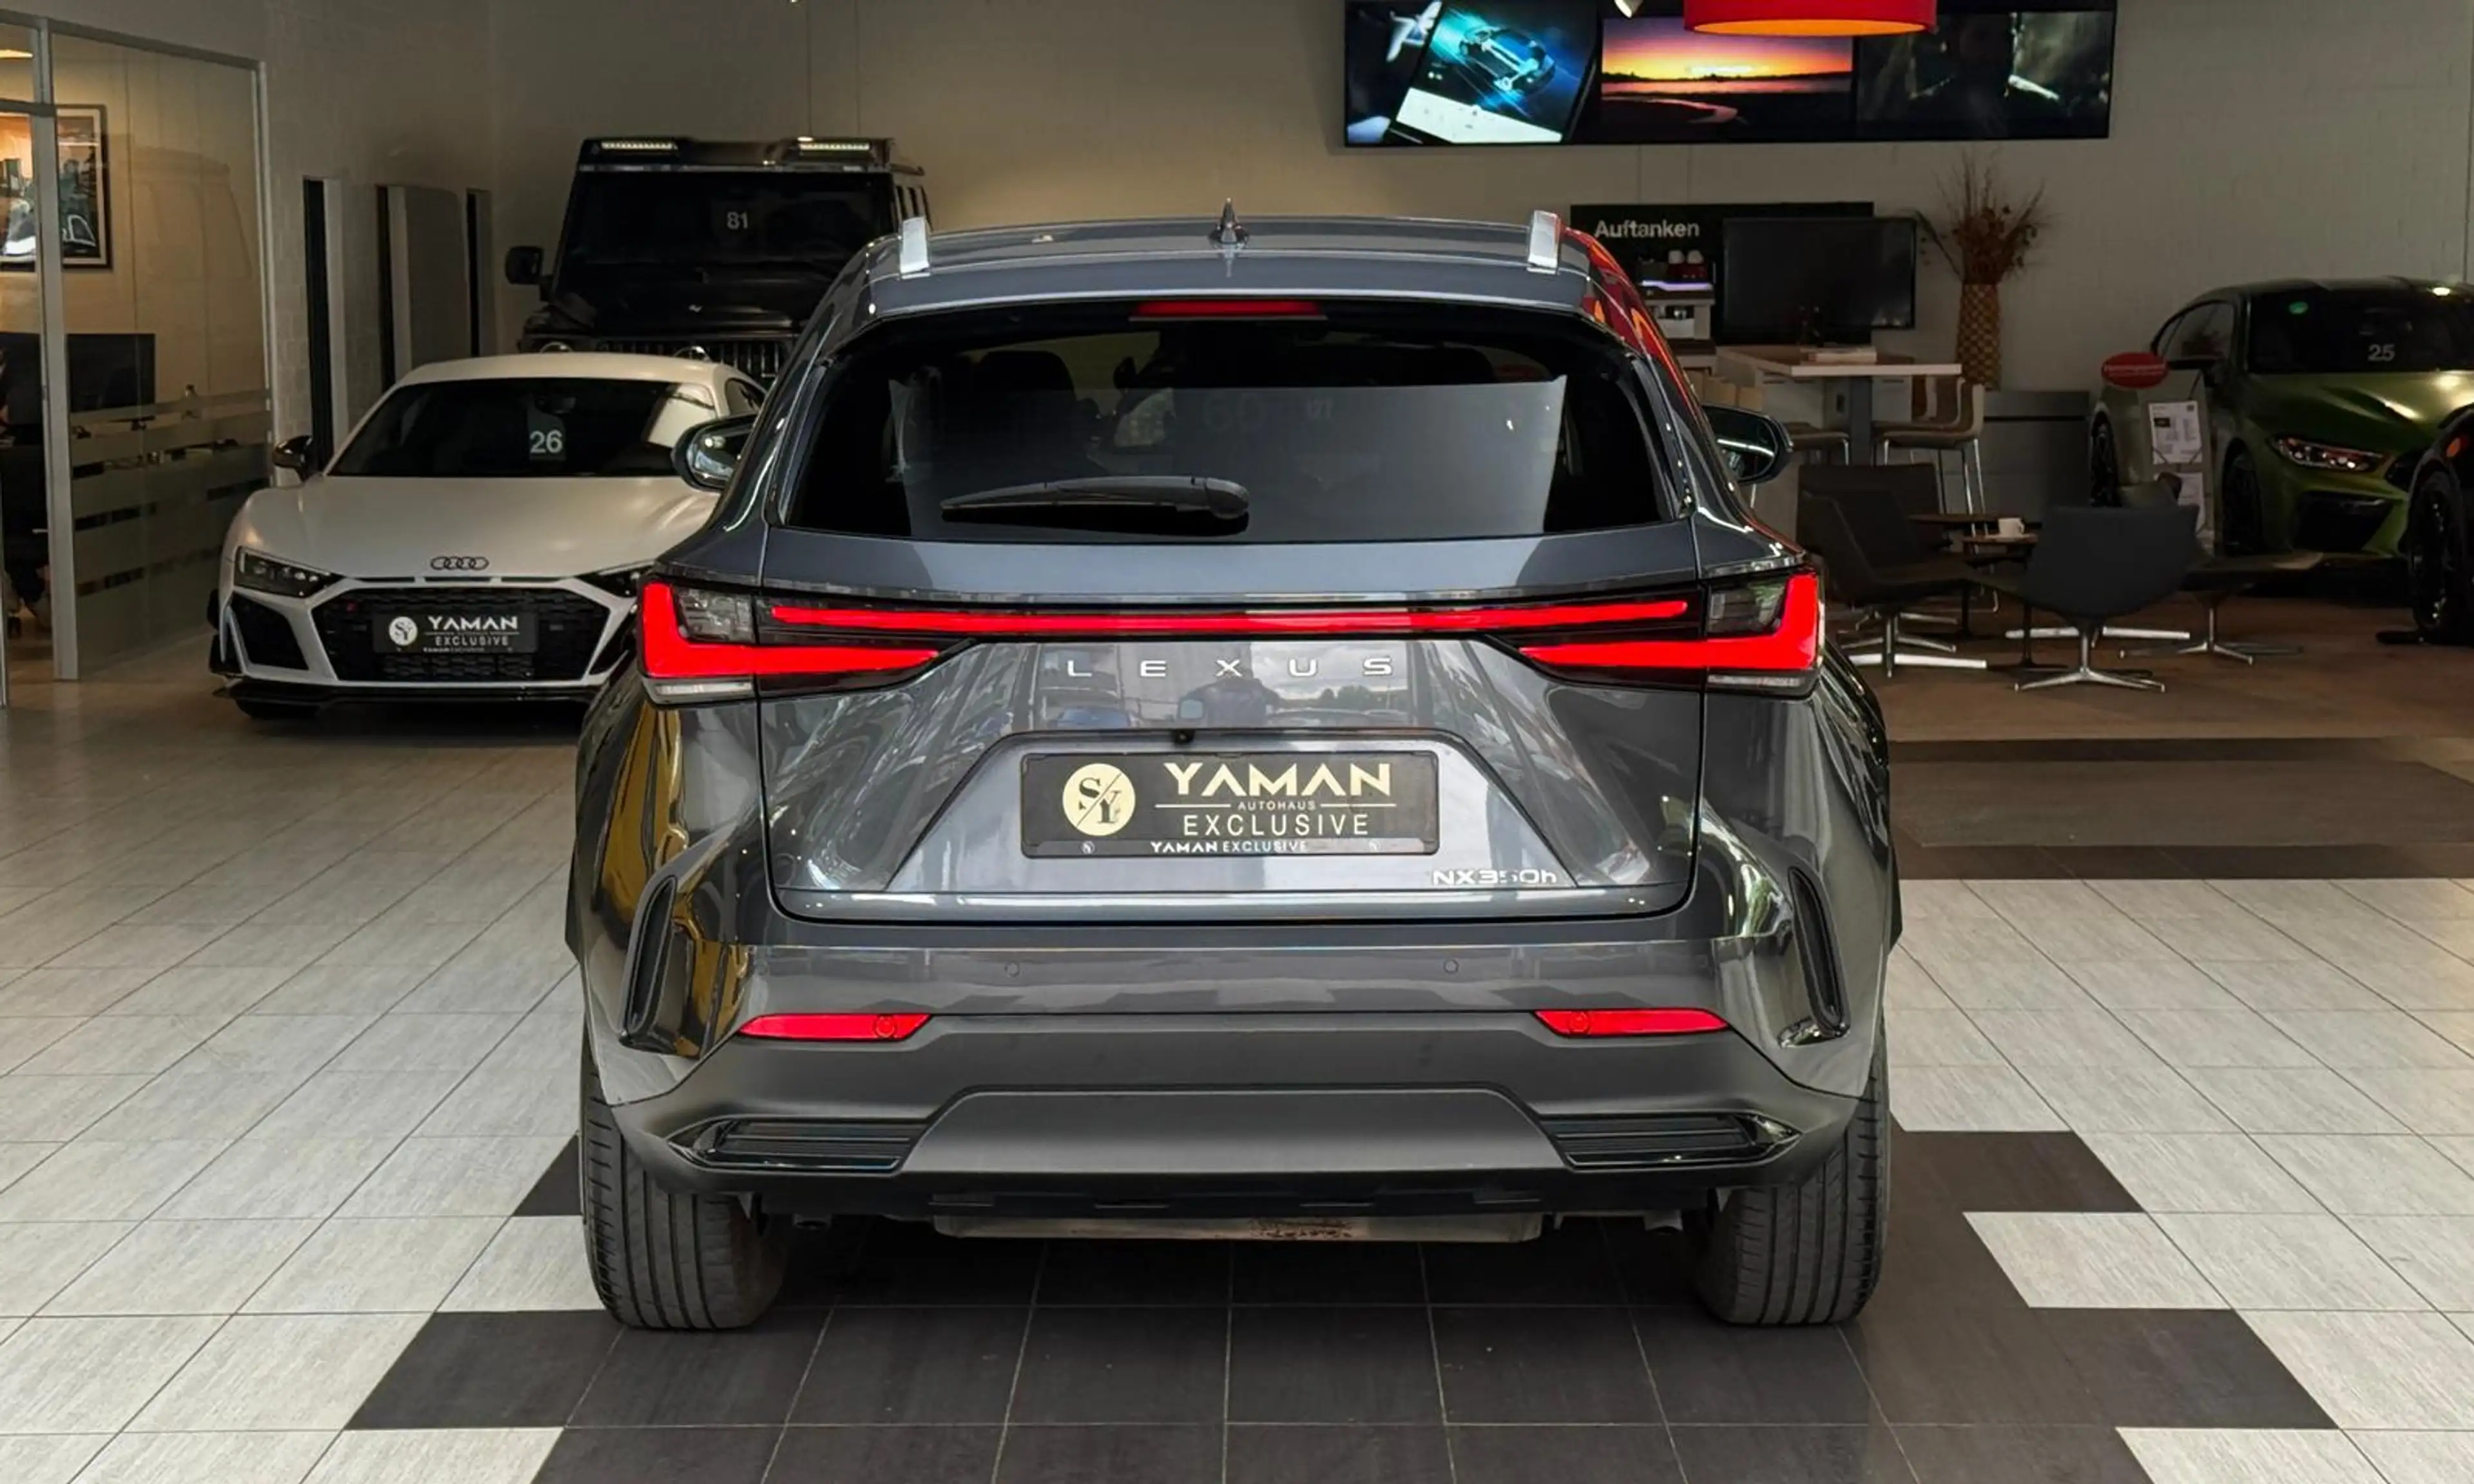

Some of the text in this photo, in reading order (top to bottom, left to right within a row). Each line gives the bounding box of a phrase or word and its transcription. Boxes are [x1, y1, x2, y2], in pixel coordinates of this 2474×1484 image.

[727, 211, 748, 229] 81
[1594, 219, 1700, 238] Auftanken
[2368, 344, 2395, 361] 25
[530, 430, 563, 453] 26
[427, 616, 519, 631] YAMAN
[1067, 658, 1394, 677] LEXUS
[1163, 762, 1390, 797] YAMAN
[1237, 801, 1316, 811] AUTOHAUS
[1184, 814, 1368, 836] EXCLUSIVE
[1150, 841, 1308, 853] YAMAN EXCLUSIVE
[1432, 870, 1557, 886] NX350h
